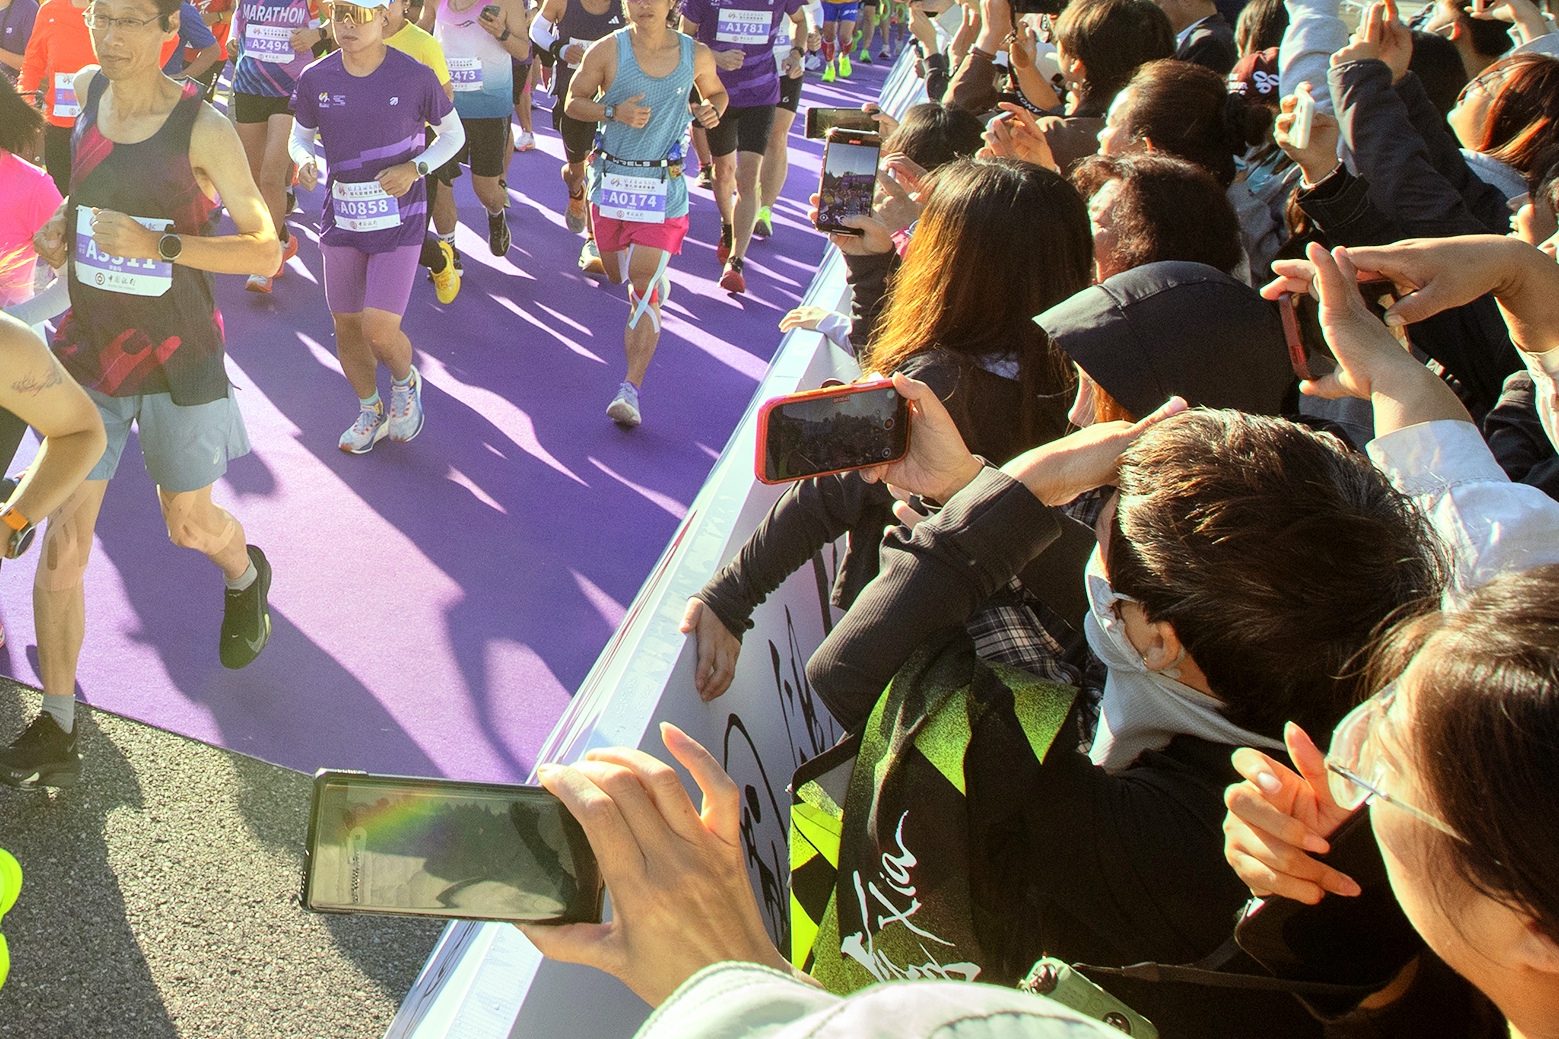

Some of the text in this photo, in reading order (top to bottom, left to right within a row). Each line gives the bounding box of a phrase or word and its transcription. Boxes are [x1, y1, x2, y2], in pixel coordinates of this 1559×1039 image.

[242, 3, 306, 24] MARATHON
[725, 22, 764, 34] A1781
[251, 38, 290, 52] A2494
[448, 70, 477, 82] 2473
[340, 199, 389, 215] A0858
[608, 191, 657, 208] A0174
